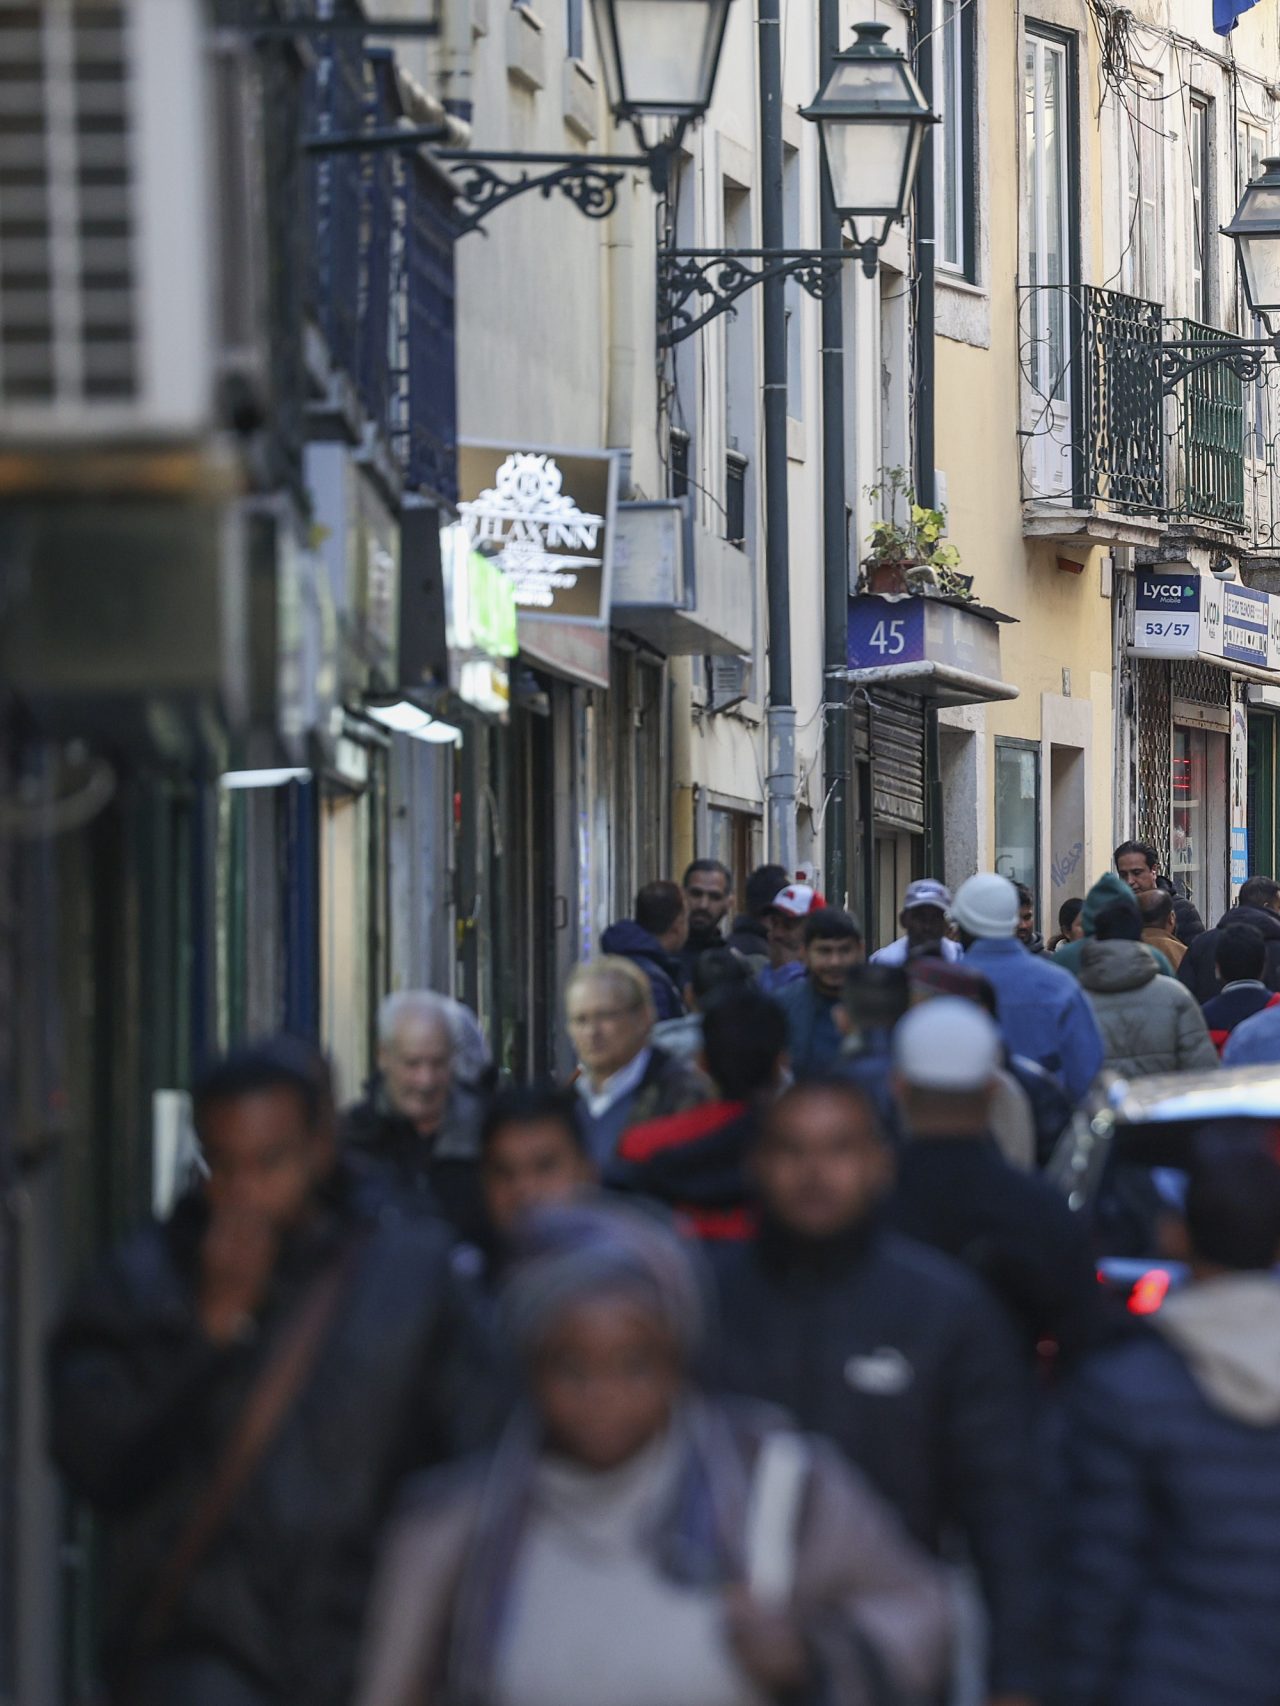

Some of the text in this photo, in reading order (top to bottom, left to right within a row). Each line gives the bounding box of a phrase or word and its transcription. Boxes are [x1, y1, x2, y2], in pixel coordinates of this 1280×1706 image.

[1143, 581, 1182, 599] Lyca
[869, 620, 905, 655] 45
[1145, 622, 1190, 637] 53/57
